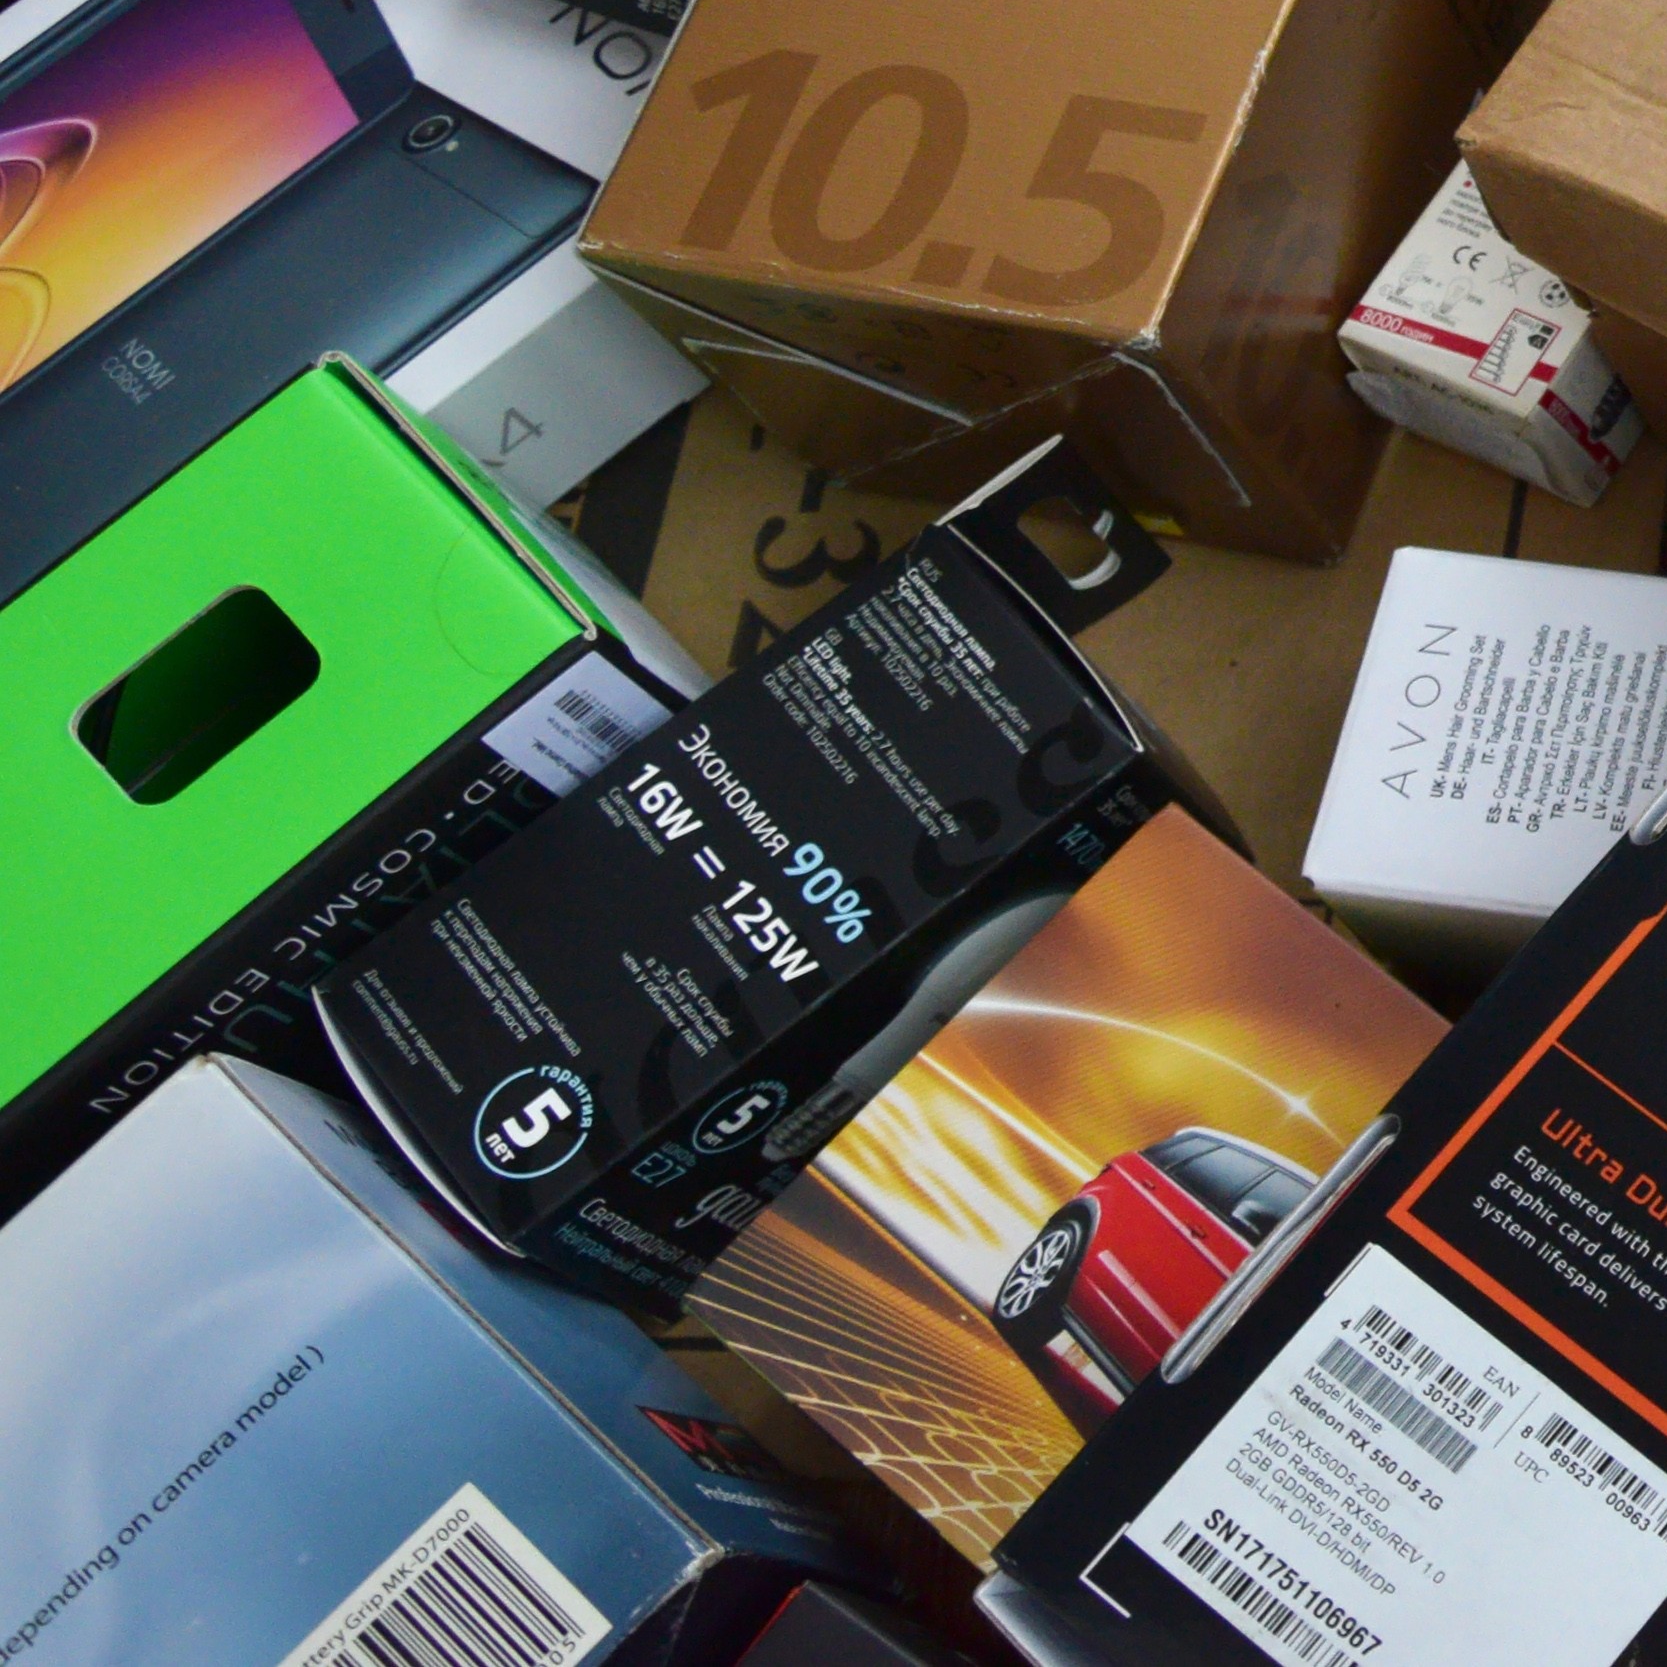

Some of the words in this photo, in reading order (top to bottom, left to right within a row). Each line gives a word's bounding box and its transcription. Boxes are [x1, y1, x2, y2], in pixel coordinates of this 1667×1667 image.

[679, 47, 1208, 307] 10.5
[1382, 623, 1458, 800] AVON
[274, 829, 436, 961] COSMIC
[626, 762, 704, 841] 16W
[721, 879, 819, 982] 125W
[782, 841, 872, 943] 90%
[90, 968, 270, 1114] EDITION
[502, 1077, 571, 1143] 5
[1539, 1107, 1624, 1184] Ultra
[1289, 1383, 1345, 1433] Radeon
[1344, 1428, 1371, 1452] RX
[1368, 1447, 1398, 1474] 550
[1396, 1469, 1421, 1493] D5
[1418, 1487, 1444, 1511] 2G
[382, 1506, 473, 1591] MK-D7000
[1202, 1507, 1383, 1655] SN171751106967
